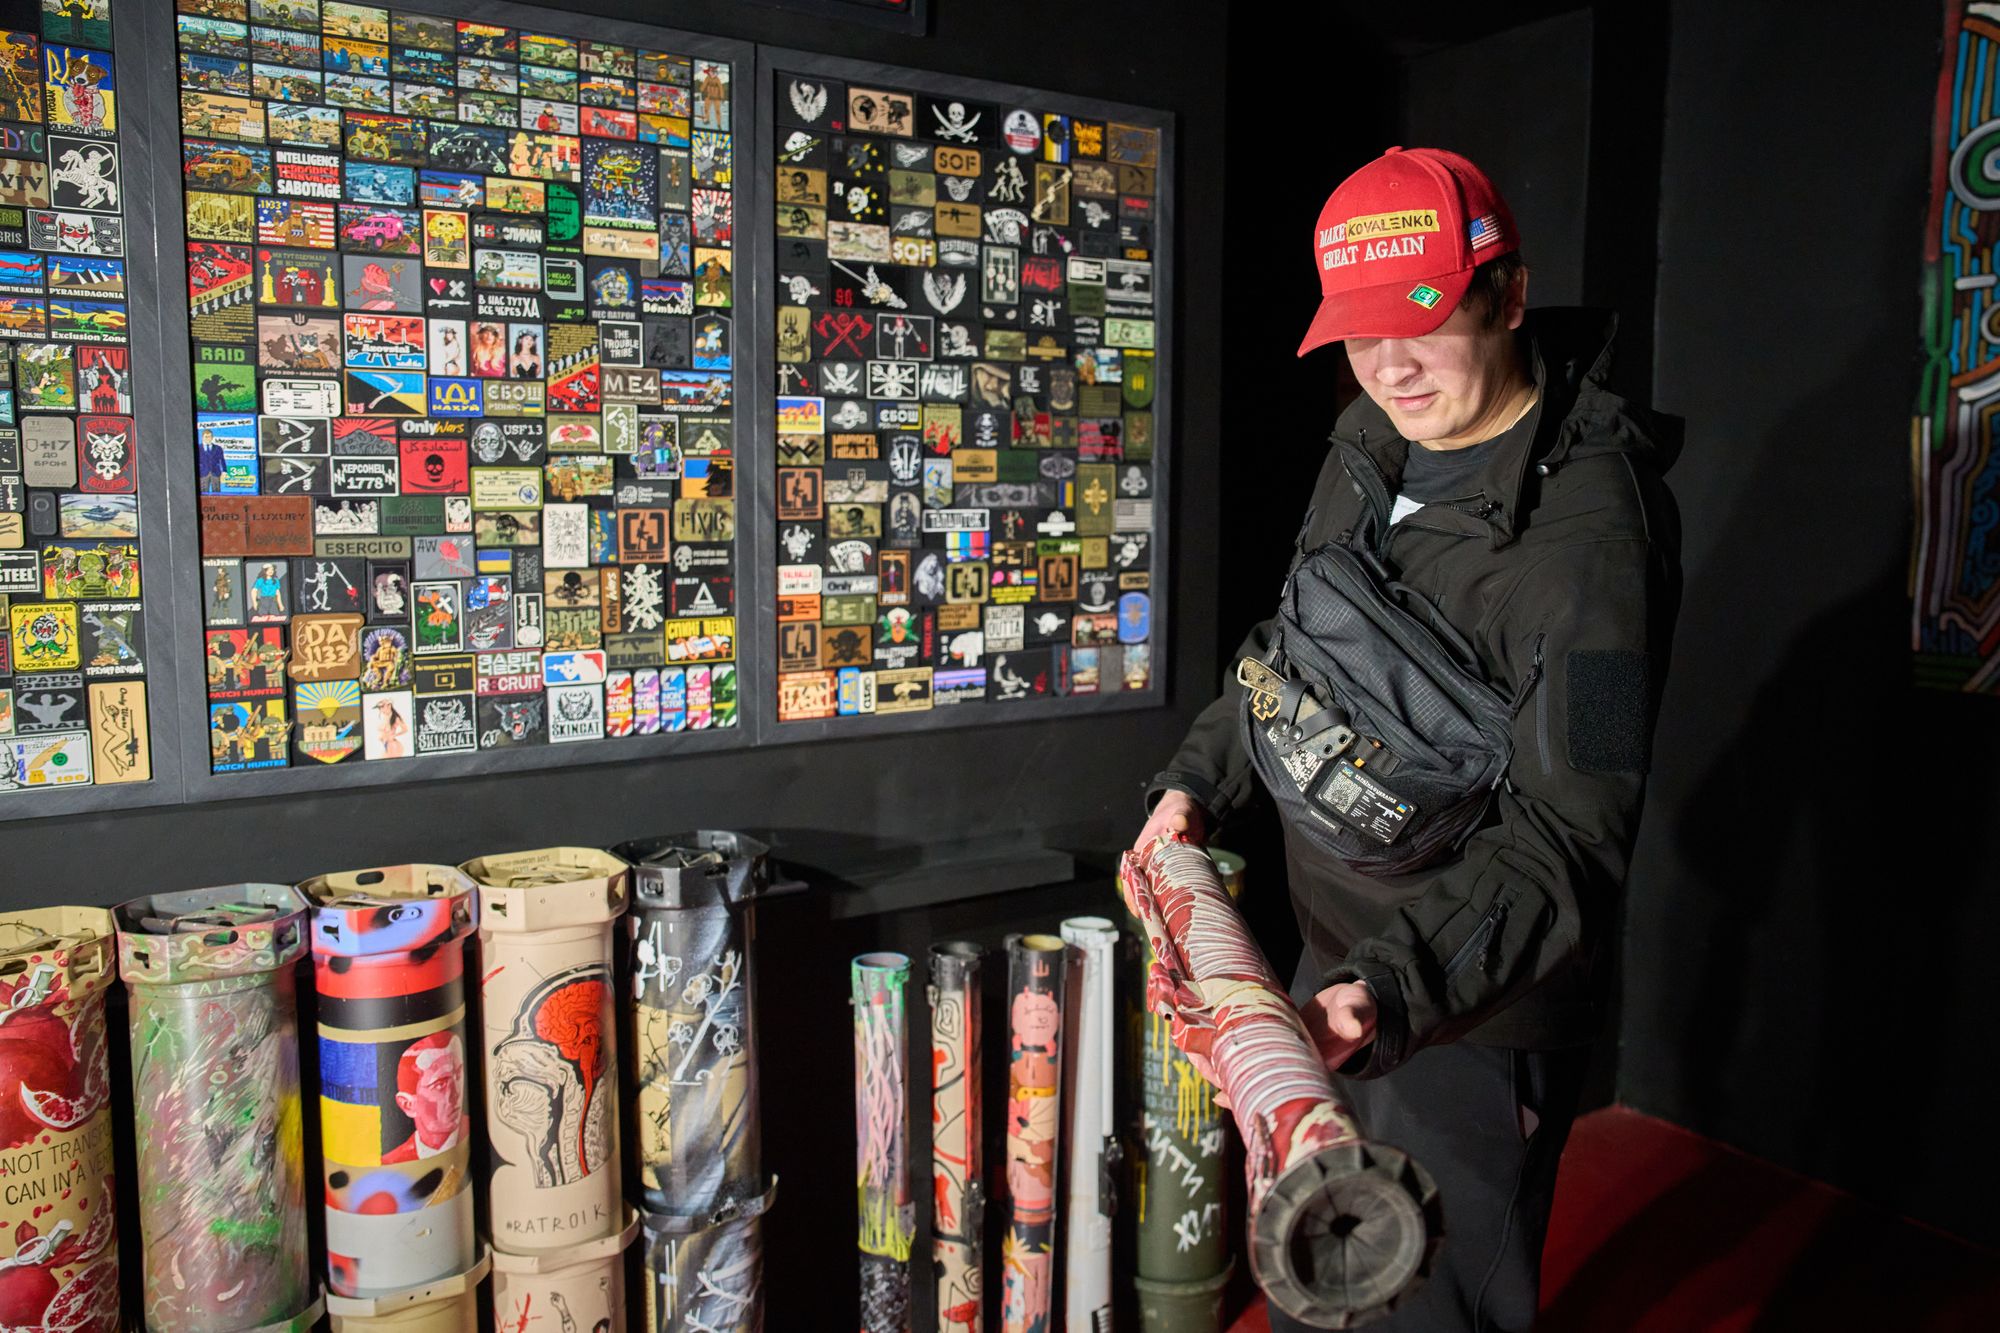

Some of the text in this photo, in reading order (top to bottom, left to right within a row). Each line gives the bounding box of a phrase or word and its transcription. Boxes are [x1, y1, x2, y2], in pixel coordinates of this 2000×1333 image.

[276, 151, 340, 167] INTELLIGENCE
[939, 152, 977, 171] SOF
[277, 179, 341, 198] SABOTAGE
[1348, 213, 1434, 237] KOVALENKO
[1319, 223, 1346, 249] MAKE
[893, 240, 933, 260] SOF
[1323, 236, 1426, 270] GREAT AGAIN
[49, 287, 125, 299] PYRAMIDAGONIA
[507, 296, 522, 307] ТУТ
[478, 306, 522, 318] ВСЕ ЧЕРЕЗ
[592, 310, 606, 320] ПЕС
[608, 311, 636, 321] ПАТРОН
[51, 331, 127, 343] Exclusion Zone
[613, 329, 630, 339] THE
[604, 338, 639, 349] TROUBLE
[202, 347, 245, 362] RAID
[610, 349, 634, 358] TRIBE
[347, 477, 384, 490] 1778
[253, 513, 305, 521] LUXURY
[325, 541, 403, 555] ESERCITO
[306, 623, 348, 646] DA
[243, 688, 283, 696] HUNTER
[19, 721, 85, 731] ANAL
[551, 721, 601, 737] SKINCAT
[247, 759, 286, 769] HUNTER
[3, 1150, 43, 1178] NOT
[5, 1178, 46, 1206] CAN
[53, 1170, 71, 1194] IN
[76, 1164, 87, 1184] A
